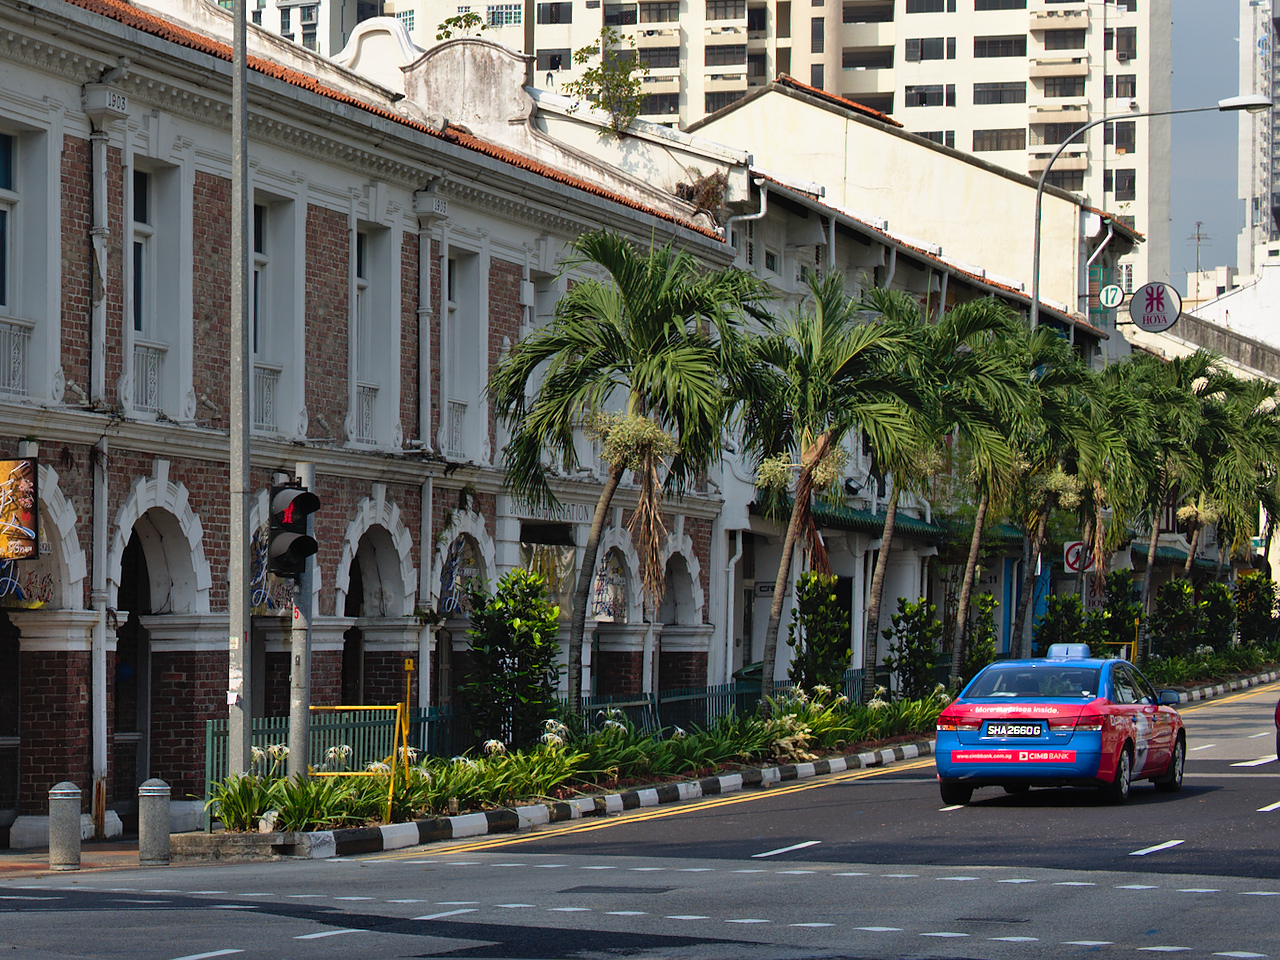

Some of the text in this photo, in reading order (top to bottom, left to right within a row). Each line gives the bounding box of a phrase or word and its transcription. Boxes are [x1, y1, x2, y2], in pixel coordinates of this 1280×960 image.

[1104, 287, 1118, 305] 17
[1142, 315, 1168, 325] HOYA
[6, 539, 33, 554] Bar
[1088, 599, 1107, 607] HOY
[294, 607, 299, 619] 5
[1033, 706, 1059, 714] inside.
